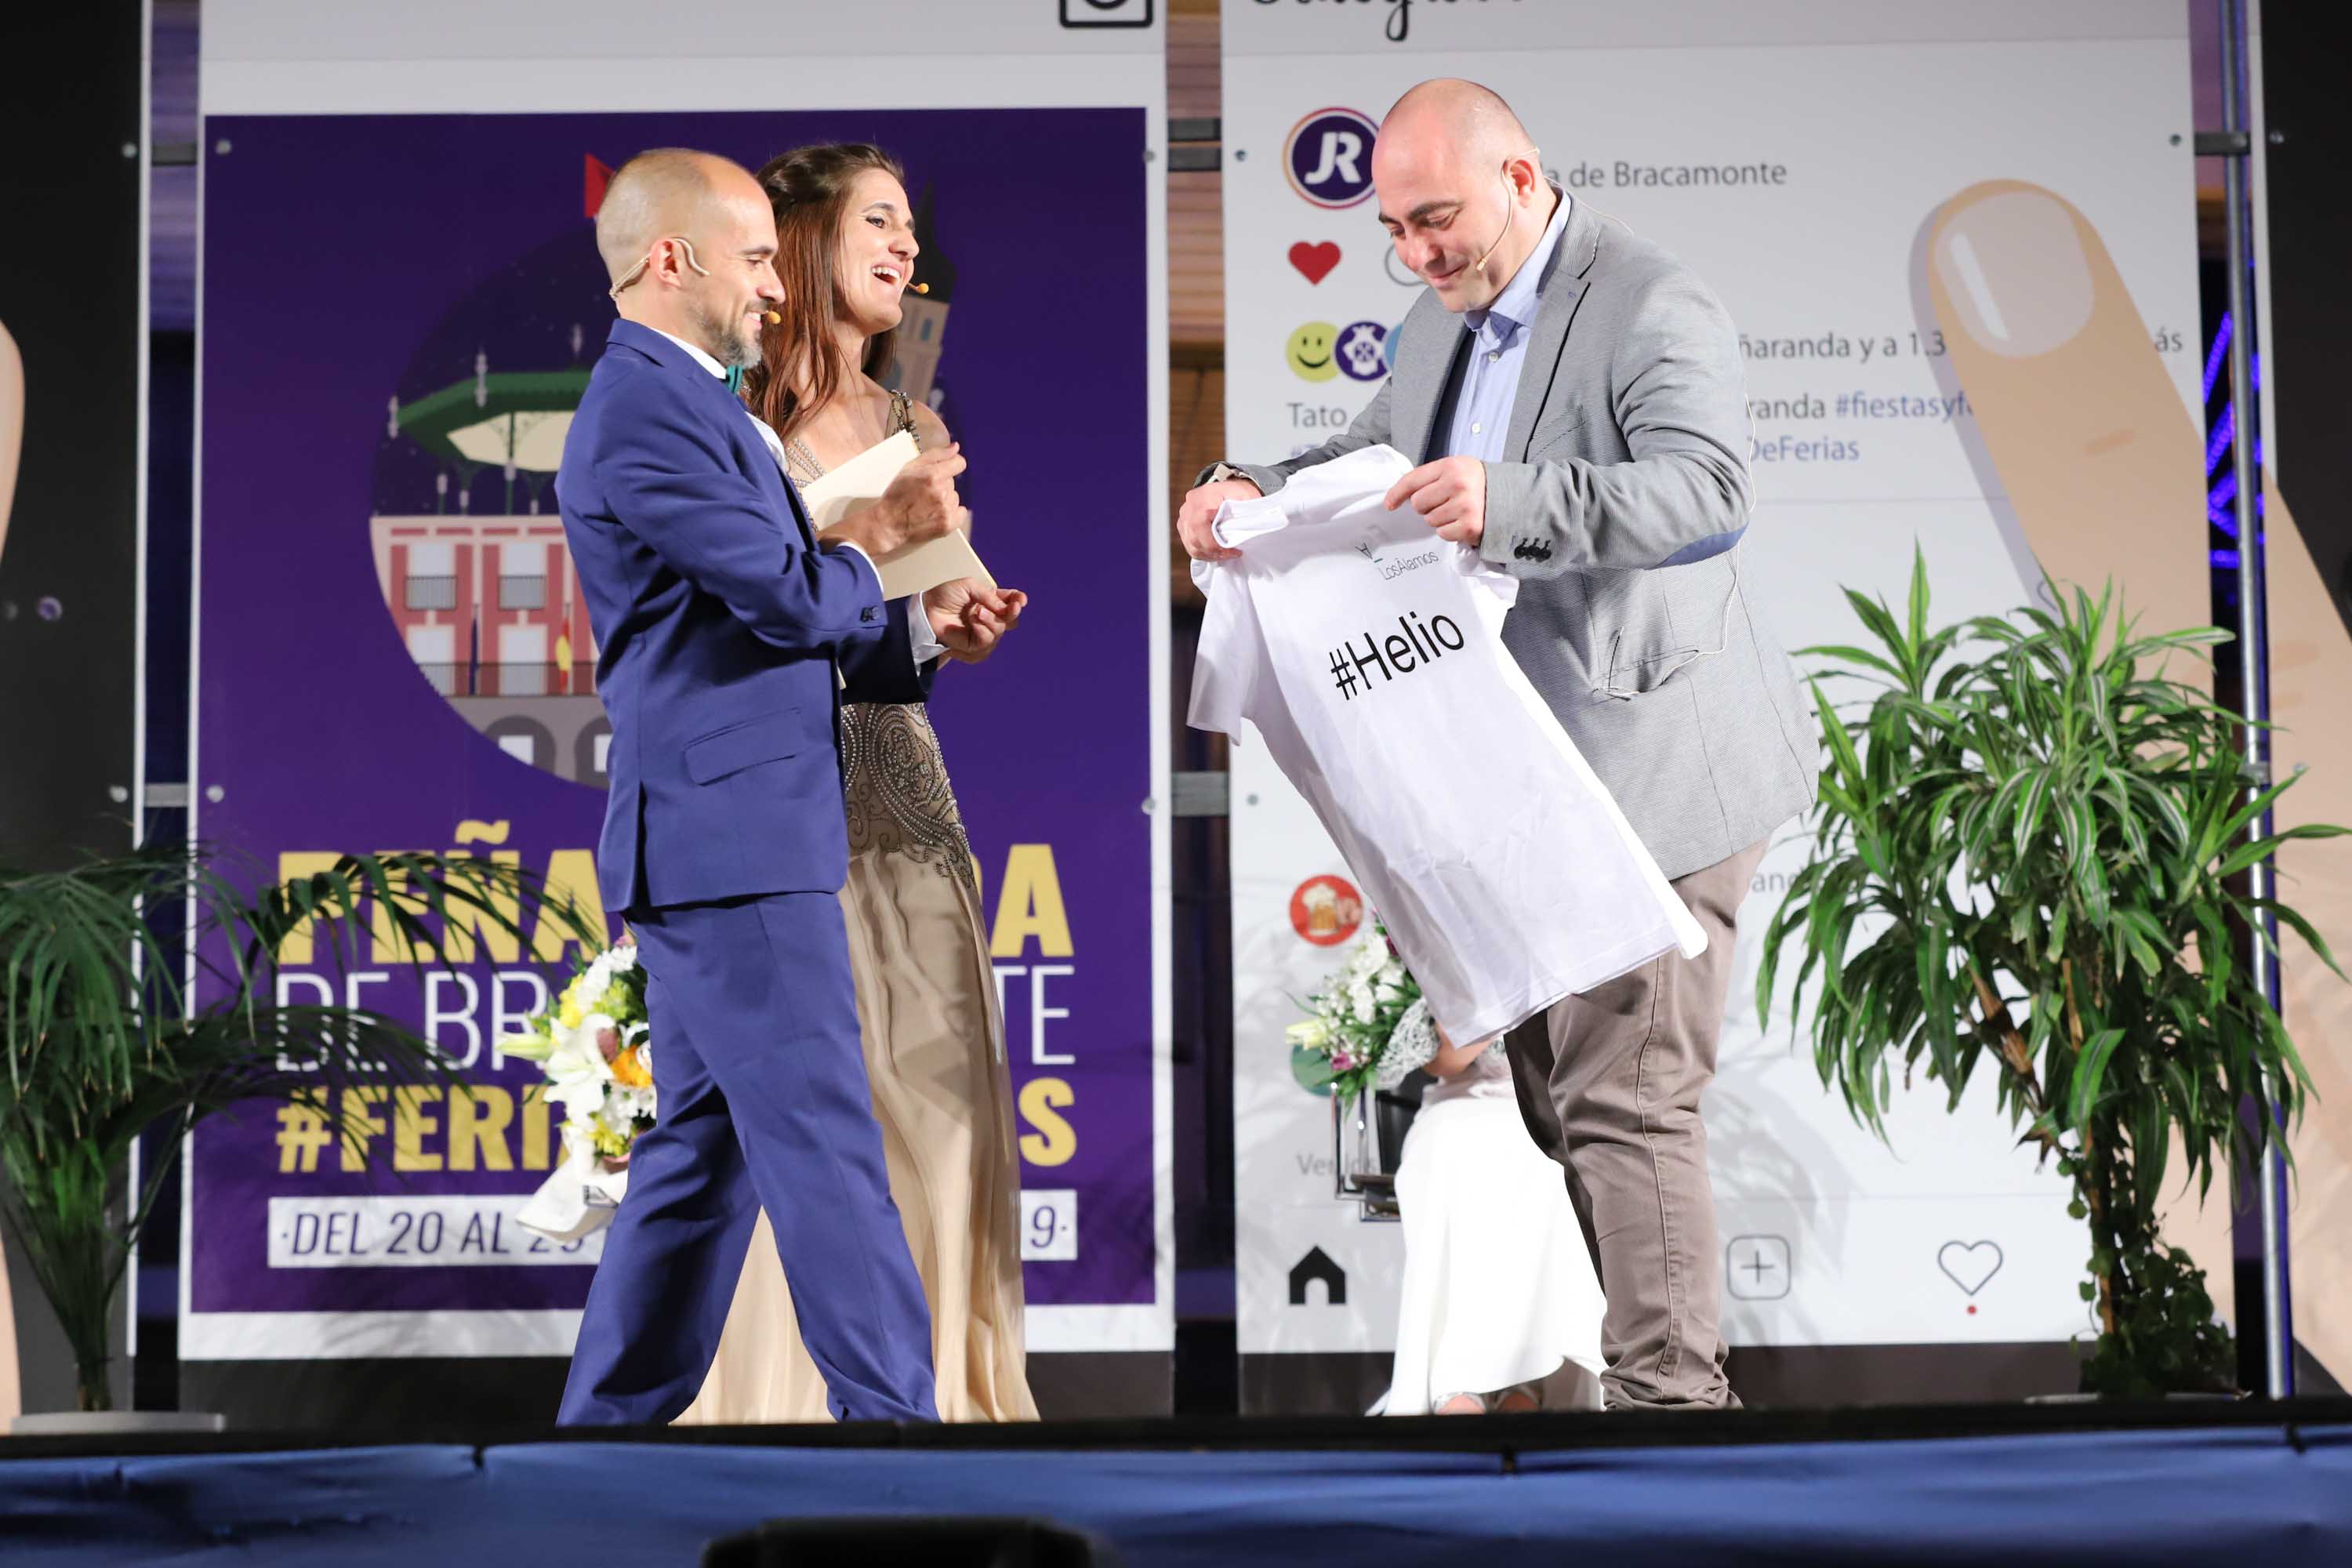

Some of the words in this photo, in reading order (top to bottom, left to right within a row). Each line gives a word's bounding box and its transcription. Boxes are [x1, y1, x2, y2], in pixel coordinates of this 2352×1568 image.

[1570, 161, 1605, 187] de
[1613, 161, 1787, 187] Bracamonte
[1859, 339, 1875, 363] y
[1883, 339, 1897, 356] a
[1287, 402, 1347, 428] Tato
[1329, 611, 1465, 701] #Helio
[275, 1084, 567, 1173] #FERI
[387, 1211, 443, 1254] 20
[460, 1211, 510, 1254] AL
